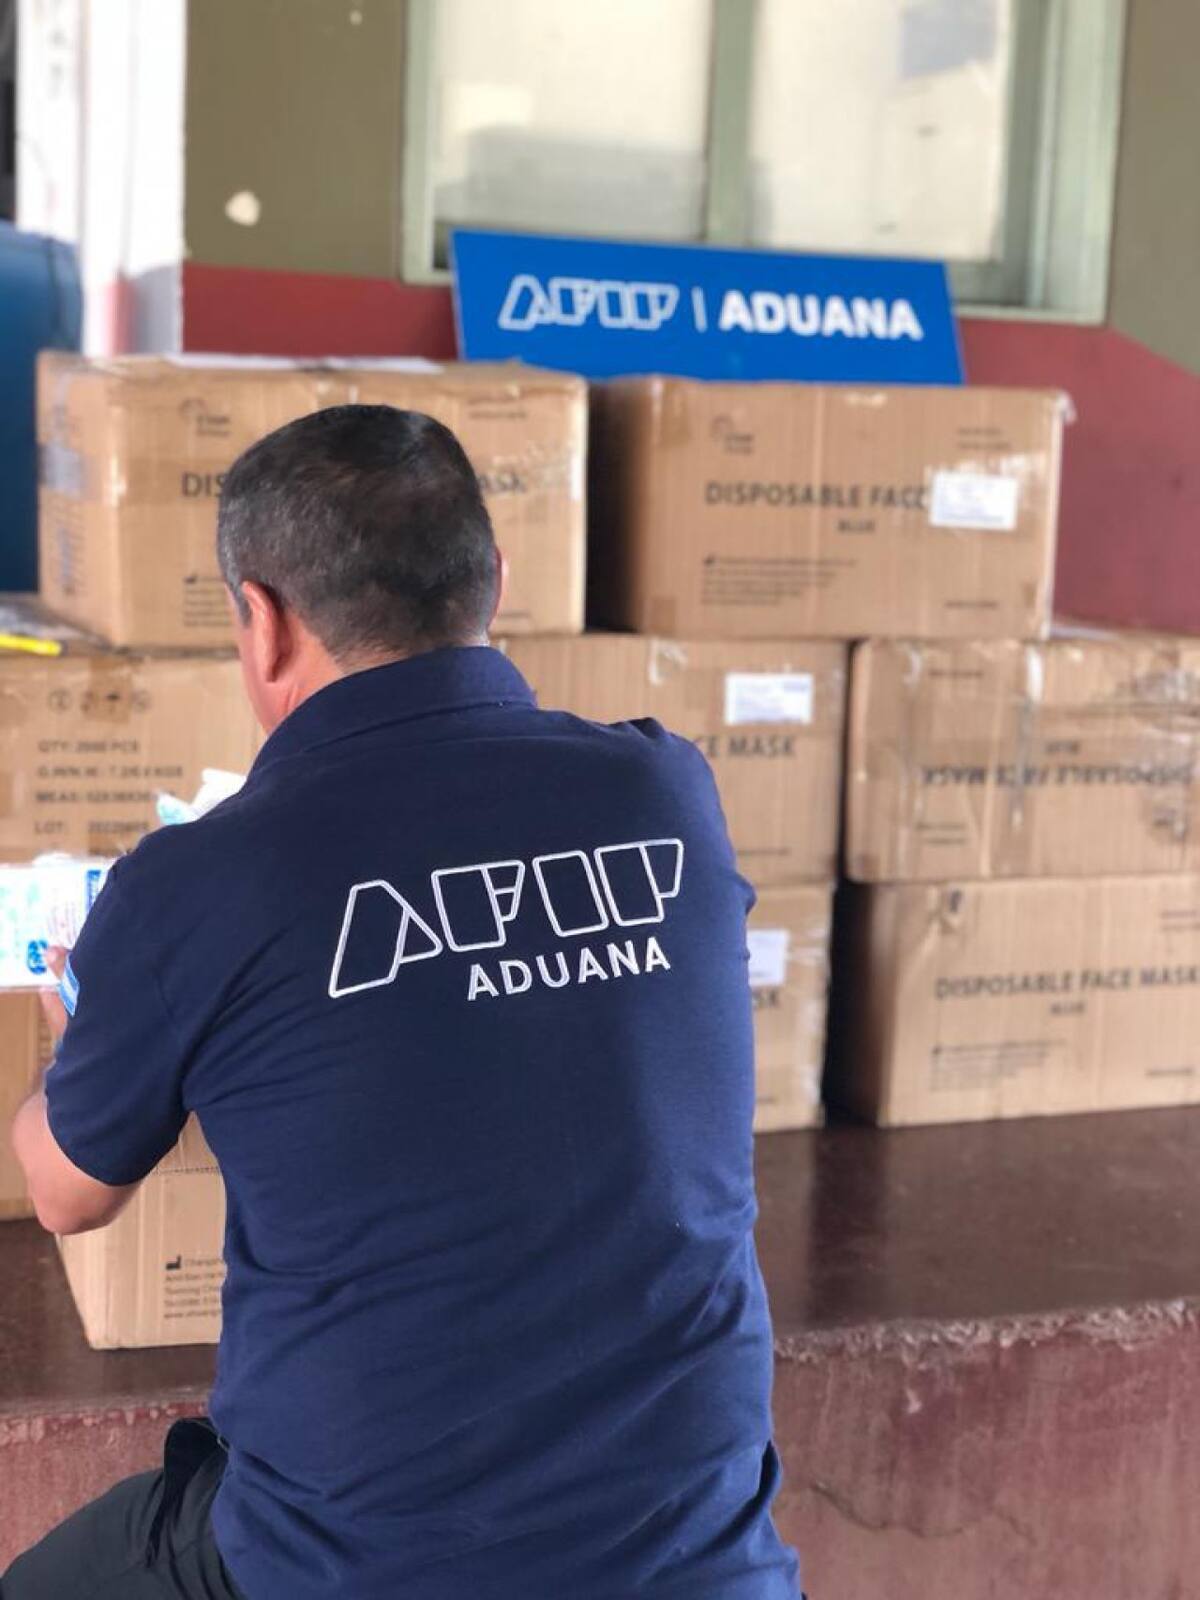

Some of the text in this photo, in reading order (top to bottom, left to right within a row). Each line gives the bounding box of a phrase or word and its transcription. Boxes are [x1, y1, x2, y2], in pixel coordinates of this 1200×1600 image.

[498, 274, 924, 341] AFIP ADUANA
[705, 481, 859, 509] DISPOSABLE
[728, 734, 796, 757] MASK
[328, 838, 684, 999] AFIP
[467, 936, 672, 1001] ADUANA
[935, 965, 1200, 999] DISPOSABLE FACE MASK
